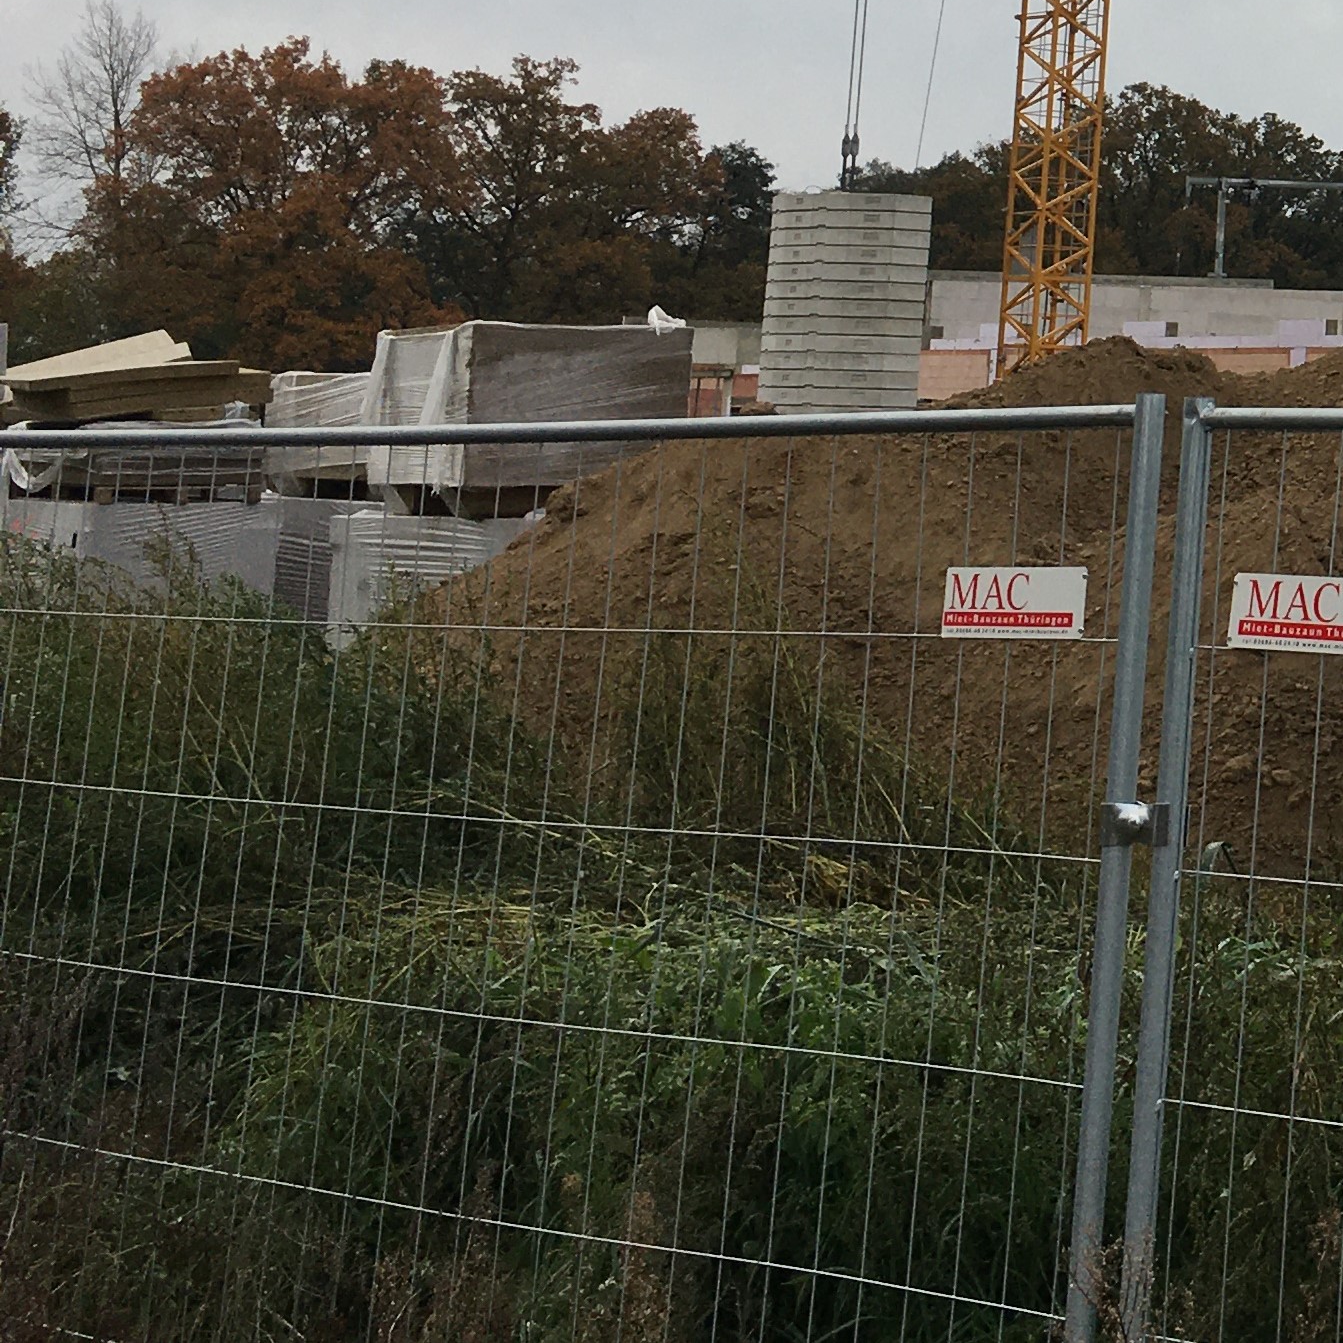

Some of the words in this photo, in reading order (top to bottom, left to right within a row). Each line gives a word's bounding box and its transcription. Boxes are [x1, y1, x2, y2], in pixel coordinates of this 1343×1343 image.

[949, 572, 1030, 610] MAC
[1245, 579, 1340, 623] MAC
[946, 613, 1014, 624] Miet-Bauzaun
[1017, 614, 1069, 626] Thüringen
[1242, 622, 1323, 636] Miet-Bauzaun
